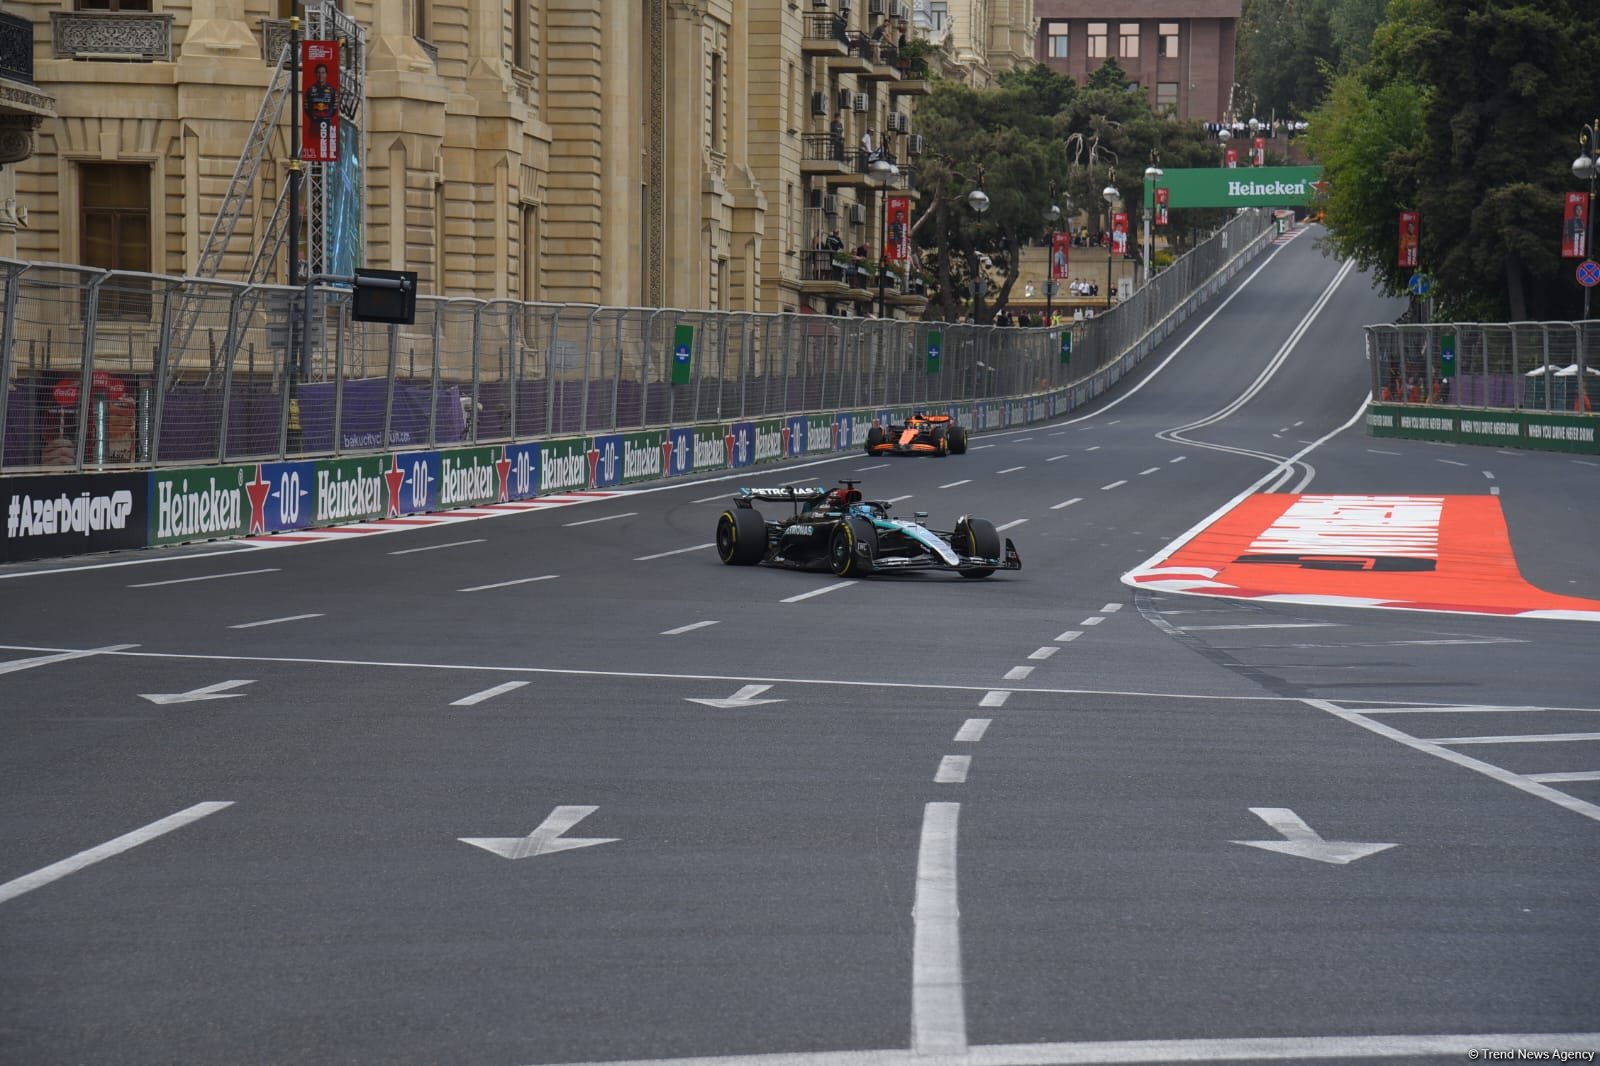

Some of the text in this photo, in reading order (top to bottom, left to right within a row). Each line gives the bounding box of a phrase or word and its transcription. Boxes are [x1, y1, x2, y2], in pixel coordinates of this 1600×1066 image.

[320, 121, 328, 158] SERGIO
[1228, 181, 1305, 196] Heineken
[541, 446, 585, 490] Heineken
[624, 438, 660, 478] Heineken
[693, 431, 724, 467] Heineken
[317, 466, 382, 520] Heineken
[441, 456, 494, 504] Heineken
[8, 490, 132, 538] #AzerbaijanGP
[157, 477, 241, 538] Heineken
